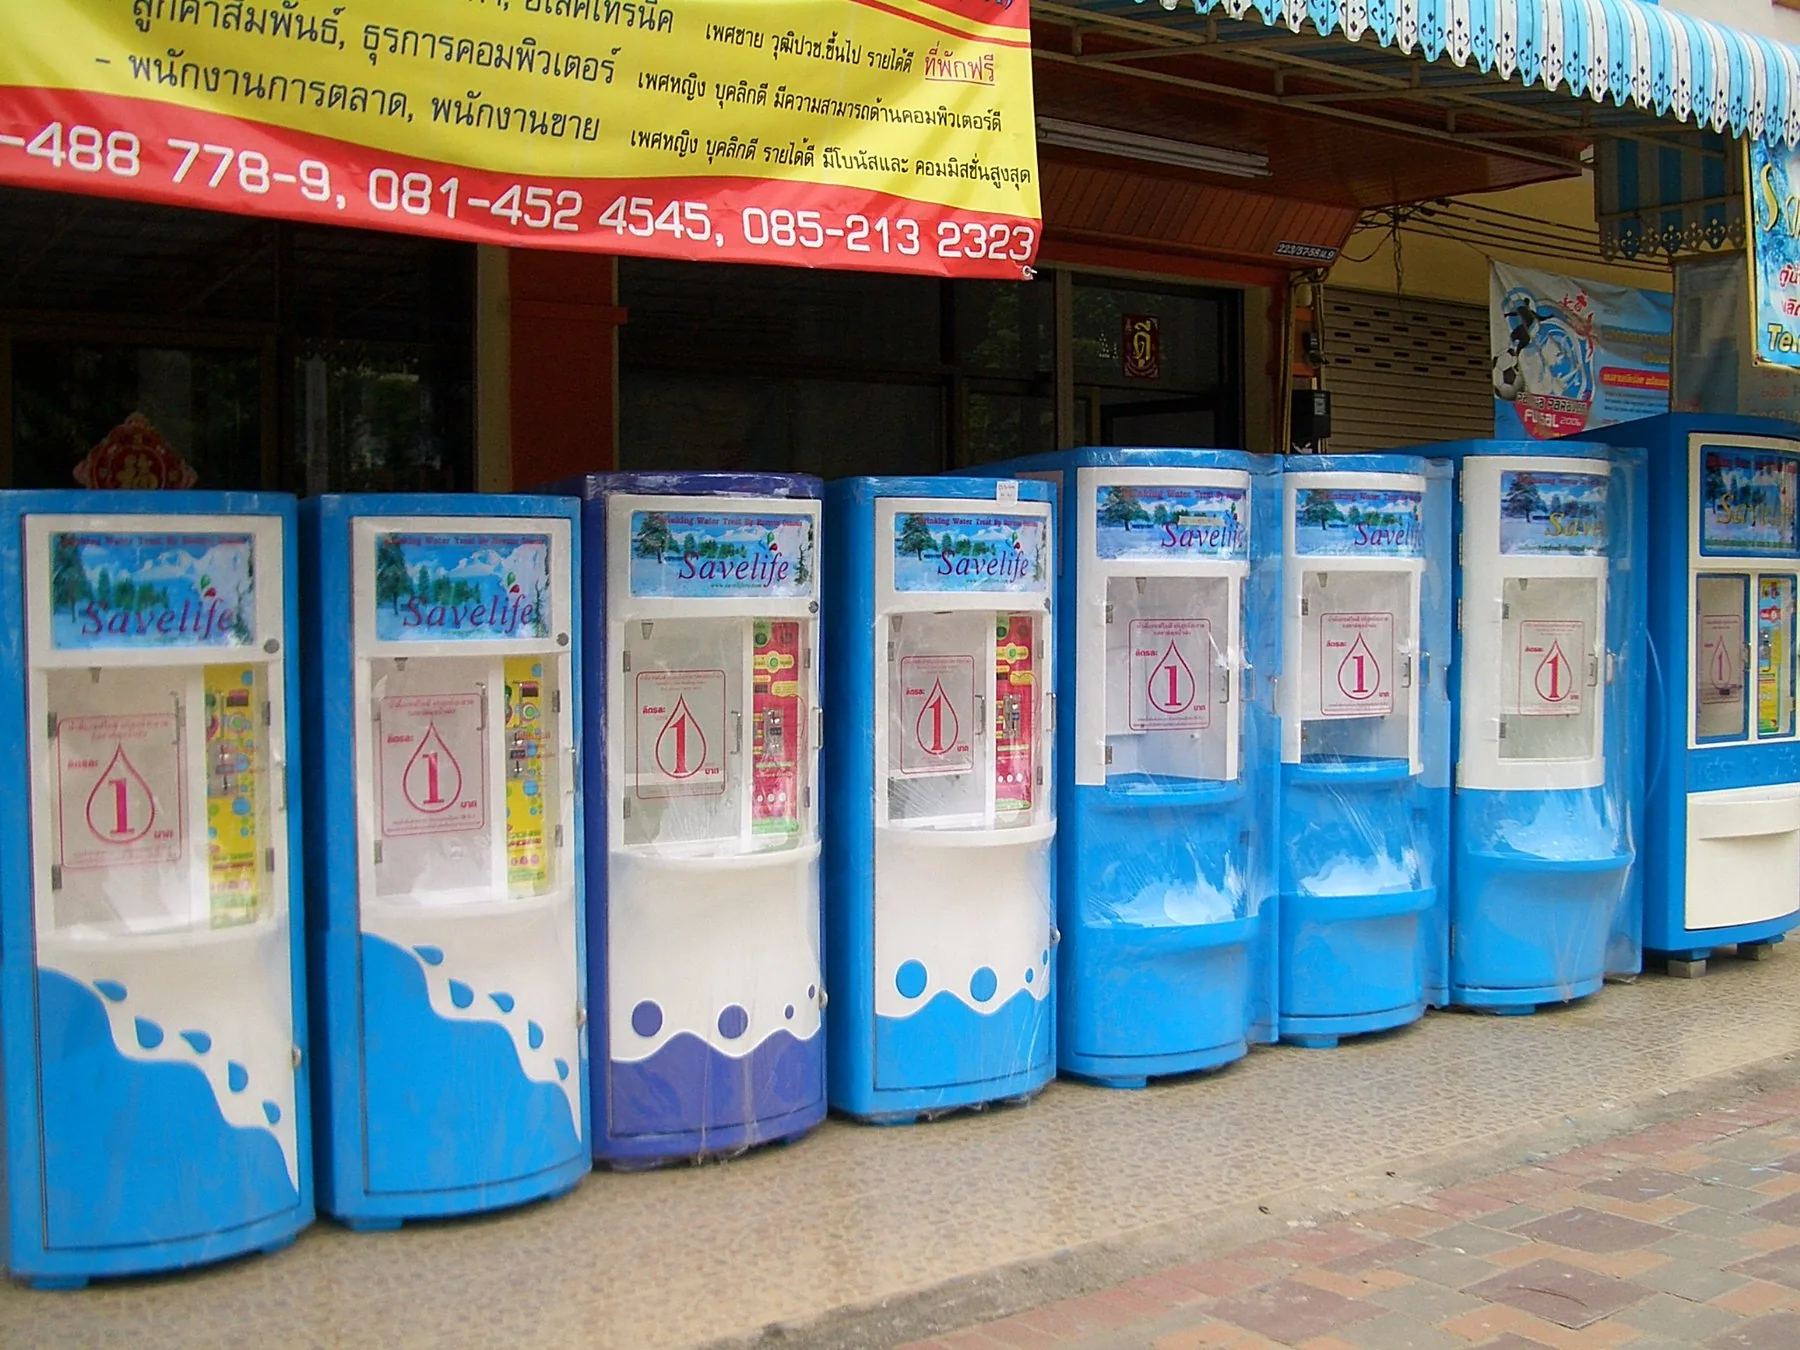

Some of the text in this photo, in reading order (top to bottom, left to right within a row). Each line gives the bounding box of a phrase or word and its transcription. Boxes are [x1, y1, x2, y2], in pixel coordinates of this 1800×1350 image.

[363, 24, 621, 84] ธุรการคอมพิวเตอร์
[706, 24, 764, 49] เพศชาย
[925, 41, 994, 83] ที่พักฟรี
[638, 72, 706, 101] เพศหญิง
[715, 80, 768, 109] บุคลิกดี
[431, 91, 600, 141] พนักงานขาย
[630, 129, 698, 157] เพศหญิง
[706, 136, 758, 164] บุคลิกดี
[764, 137, 814, 167] รายได้ดี
[822, 147, 908, 173] มีโบนัสและ
[167, 138, 346, 210] 778-9,
[368, 167, 583, 231] 081-452
[598, 195, 725, 247] 4545,
[742, 206, 919, 255] 085-213
[937, 221, 1035, 261] 2323
[678, 551, 789, 588] Savelife
[938, 549, 1029, 583] Savelife
[81, 597, 234, 641] Savelife
[403, 594, 534, 635] Savelife
[1164, 664, 1182, 706] 1
[1352, 655, 1368, 693] 1
[1547, 653, 1560, 698] 1
[669, 711, 689, 774] 1
[928, 694, 944, 751] 1
[422, 751, 445, 804] 1
[108, 777, 135, 835] 1
